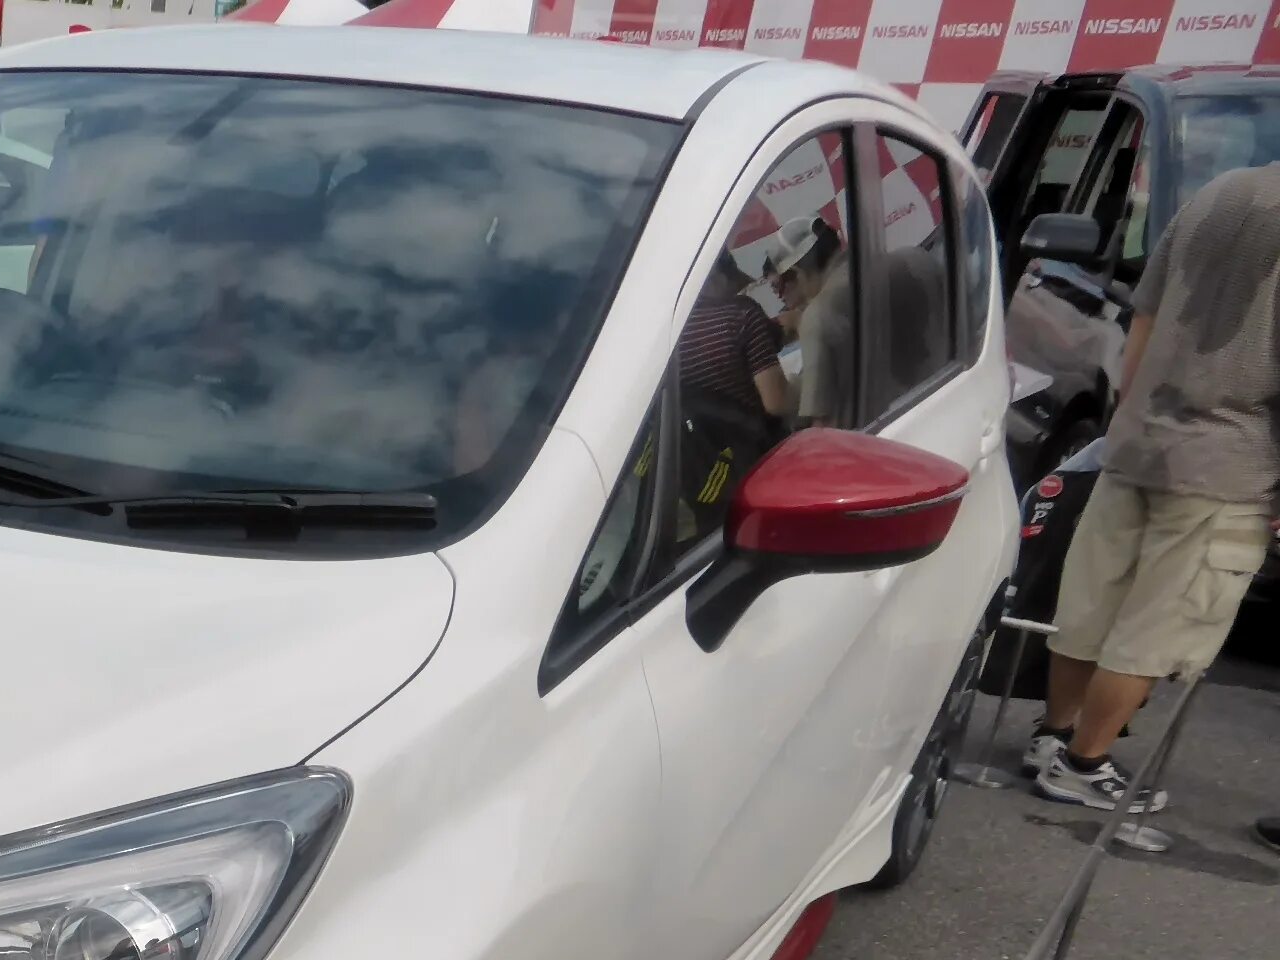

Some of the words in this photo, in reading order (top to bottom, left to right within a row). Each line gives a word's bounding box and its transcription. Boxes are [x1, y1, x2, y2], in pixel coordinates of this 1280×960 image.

[940, 22, 1003, 38] NISSAN
[1014, 20, 1073, 35] NISSAN
[1084, 18, 1162, 34] NISSAN
[1175, 14, 1257, 32] NISSAN
[655, 30, 695, 41] NISSAN
[706, 29, 745, 42] NISSAN
[754, 27, 802, 40] NISSAN
[812, 26, 861, 40] NISSAN
[872, 24, 928, 39] NISSAN
